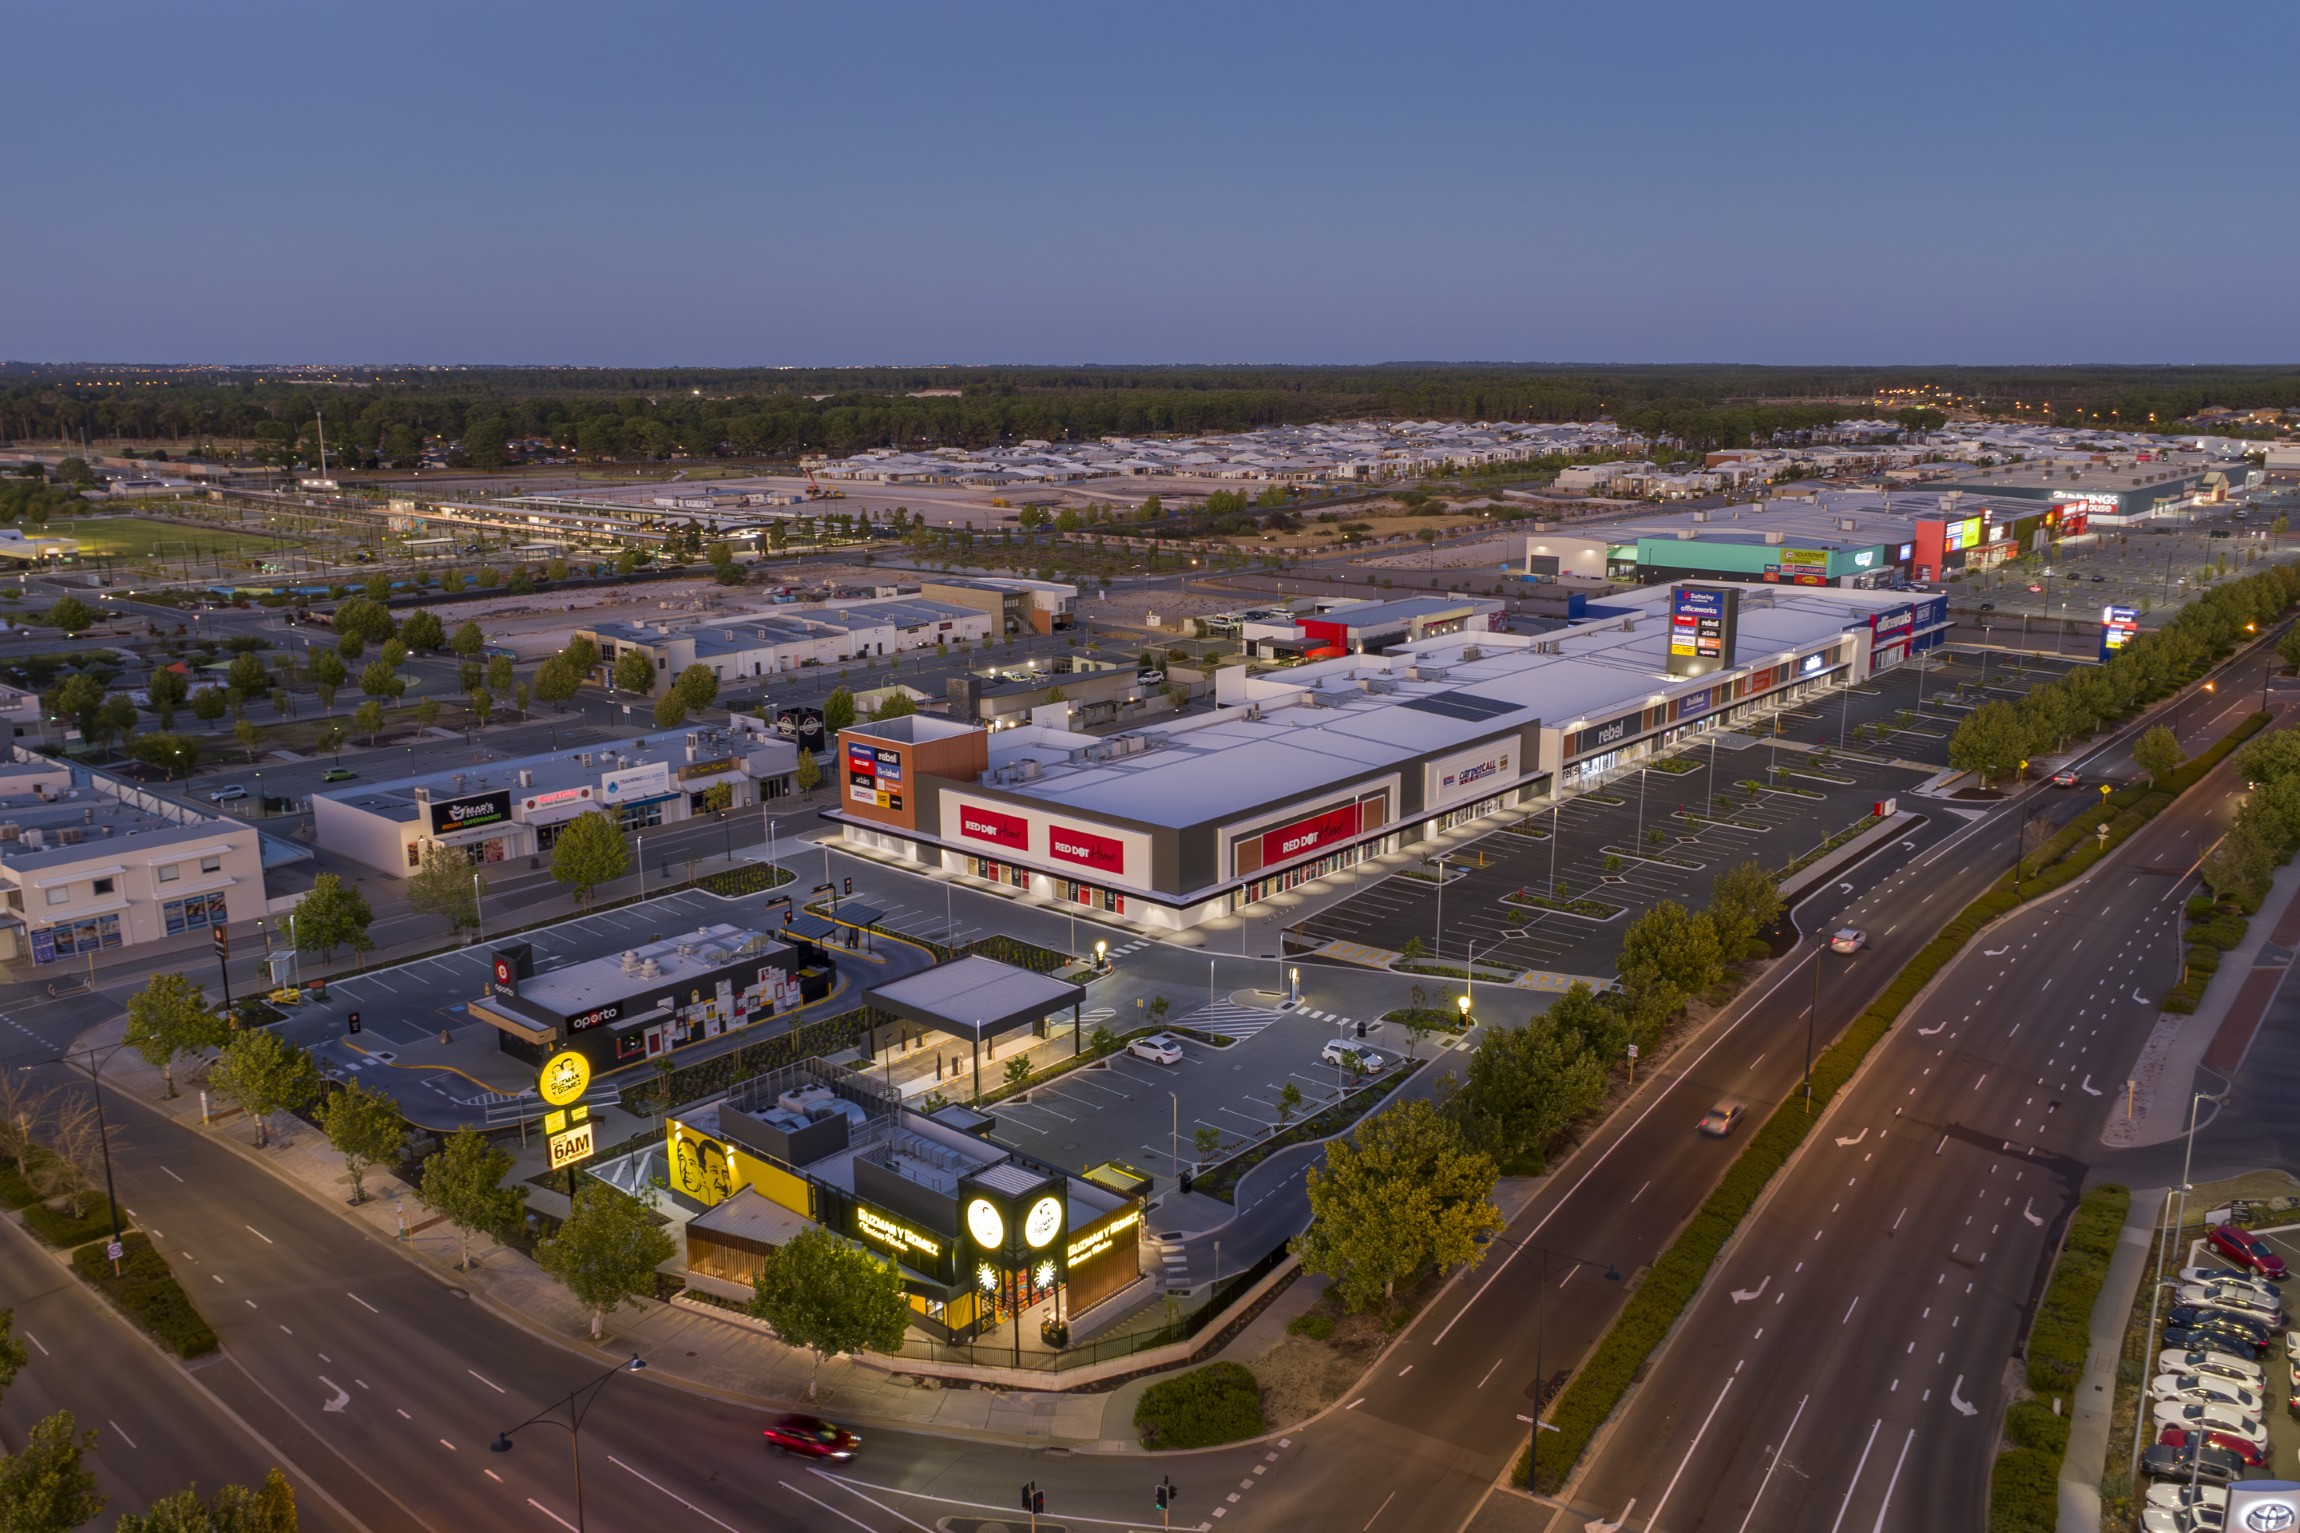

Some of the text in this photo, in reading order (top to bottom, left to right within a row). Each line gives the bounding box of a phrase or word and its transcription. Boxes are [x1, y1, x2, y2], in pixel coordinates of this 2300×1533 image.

[1680, 604, 1717, 614] officeworks
[1702, 619, 1719, 627] rebel
[1598, 720, 1624, 744] rebel
[878, 752, 897, 763] rebel
[965, 820, 980, 831] RED
[981, 825, 997, 835] DOT
[1055, 842, 1071, 854] RED
[1072, 847, 1090, 858] DOT
[1282, 838, 1300, 853] RED
[1301, 832, 1319, 847] DOT
[495, 983, 514, 997] oporto
[573, 1008, 617, 1028] oporto
[551, 1074, 579, 1090] GUZMAN
[558, 1079, 581, 1094] GOMEZ
[554, 1134, 589, 1159] 6AM
[858, 1207, 938, 1256] GUZMAN Y GOMEZ
[1068, 1211, 1139, 1257] GUZMAN Y GOMEZ
